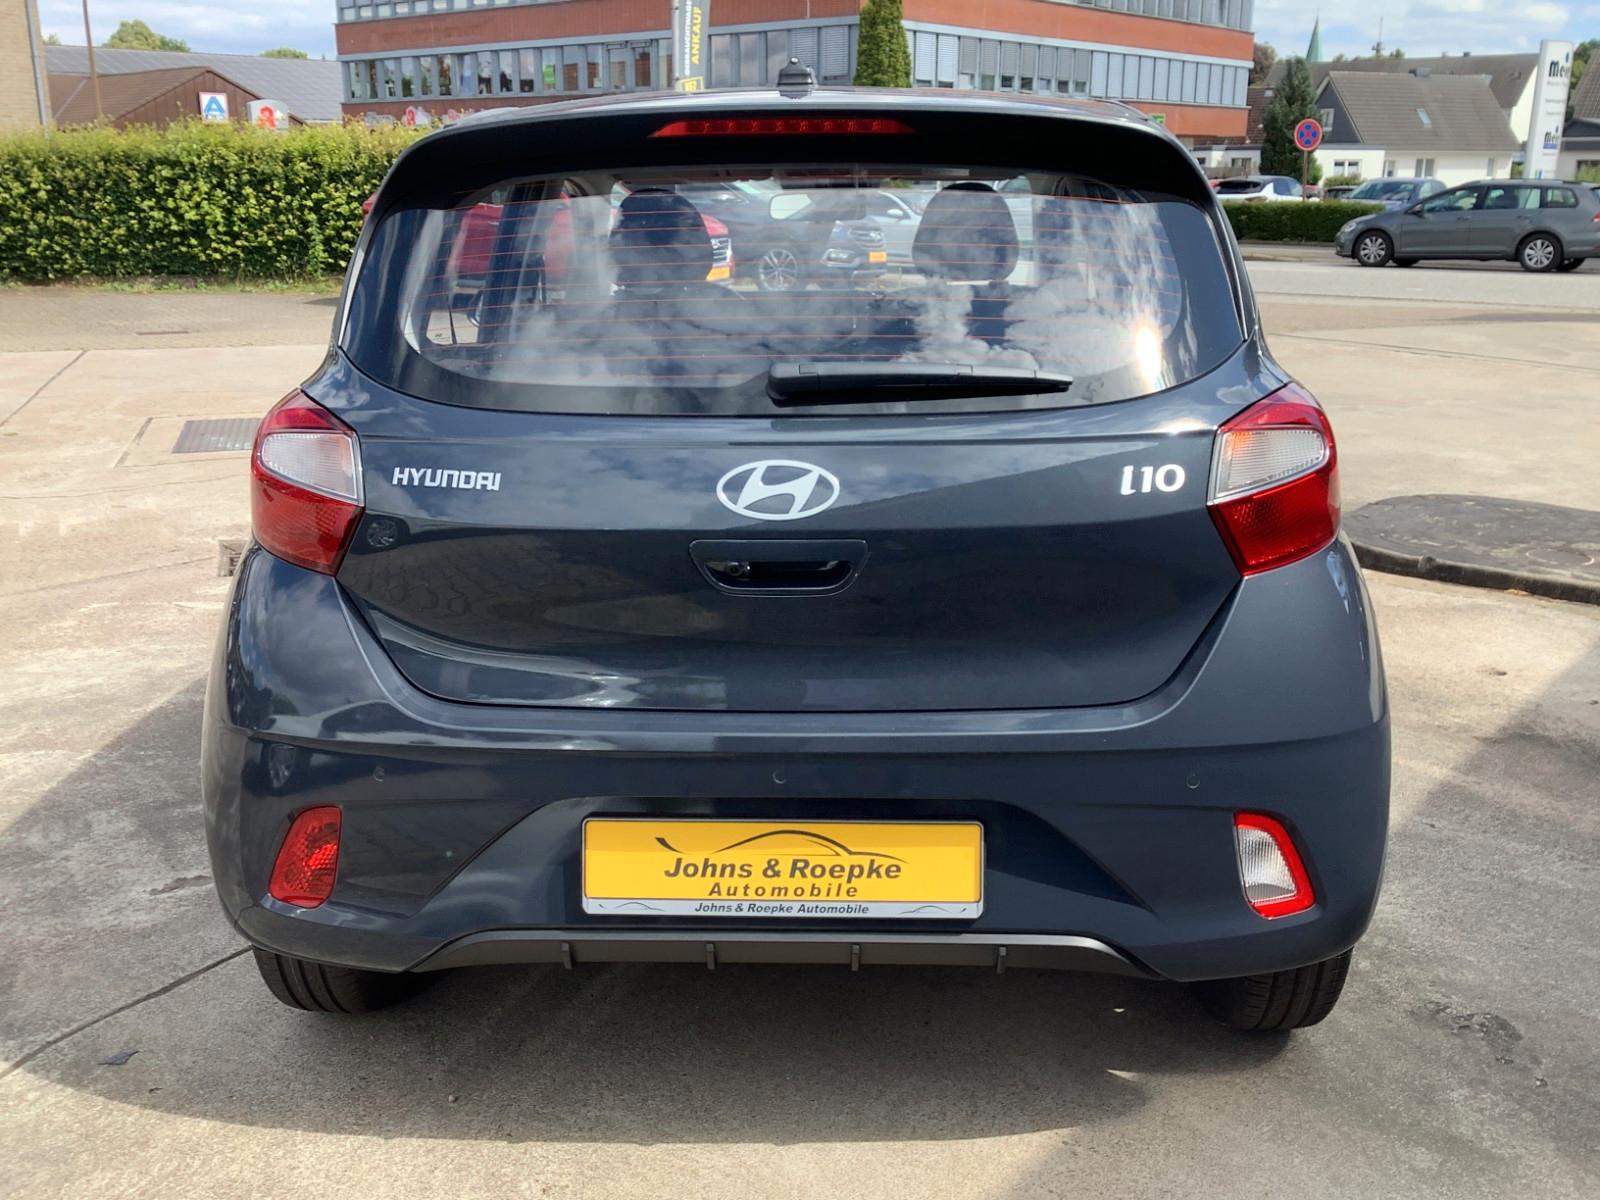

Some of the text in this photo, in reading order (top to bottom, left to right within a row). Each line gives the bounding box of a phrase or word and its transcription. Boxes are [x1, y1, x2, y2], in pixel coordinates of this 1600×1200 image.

[691, 6, 702, 65] ANKAUF
[391, 467, 501, 491] HYUNDAI
[664, 857, 901, 884] Johns & Roepke
[708, 882, 858, 897] Automobile
[695, 902, 869, 914] Johns & Roepke Automobile
